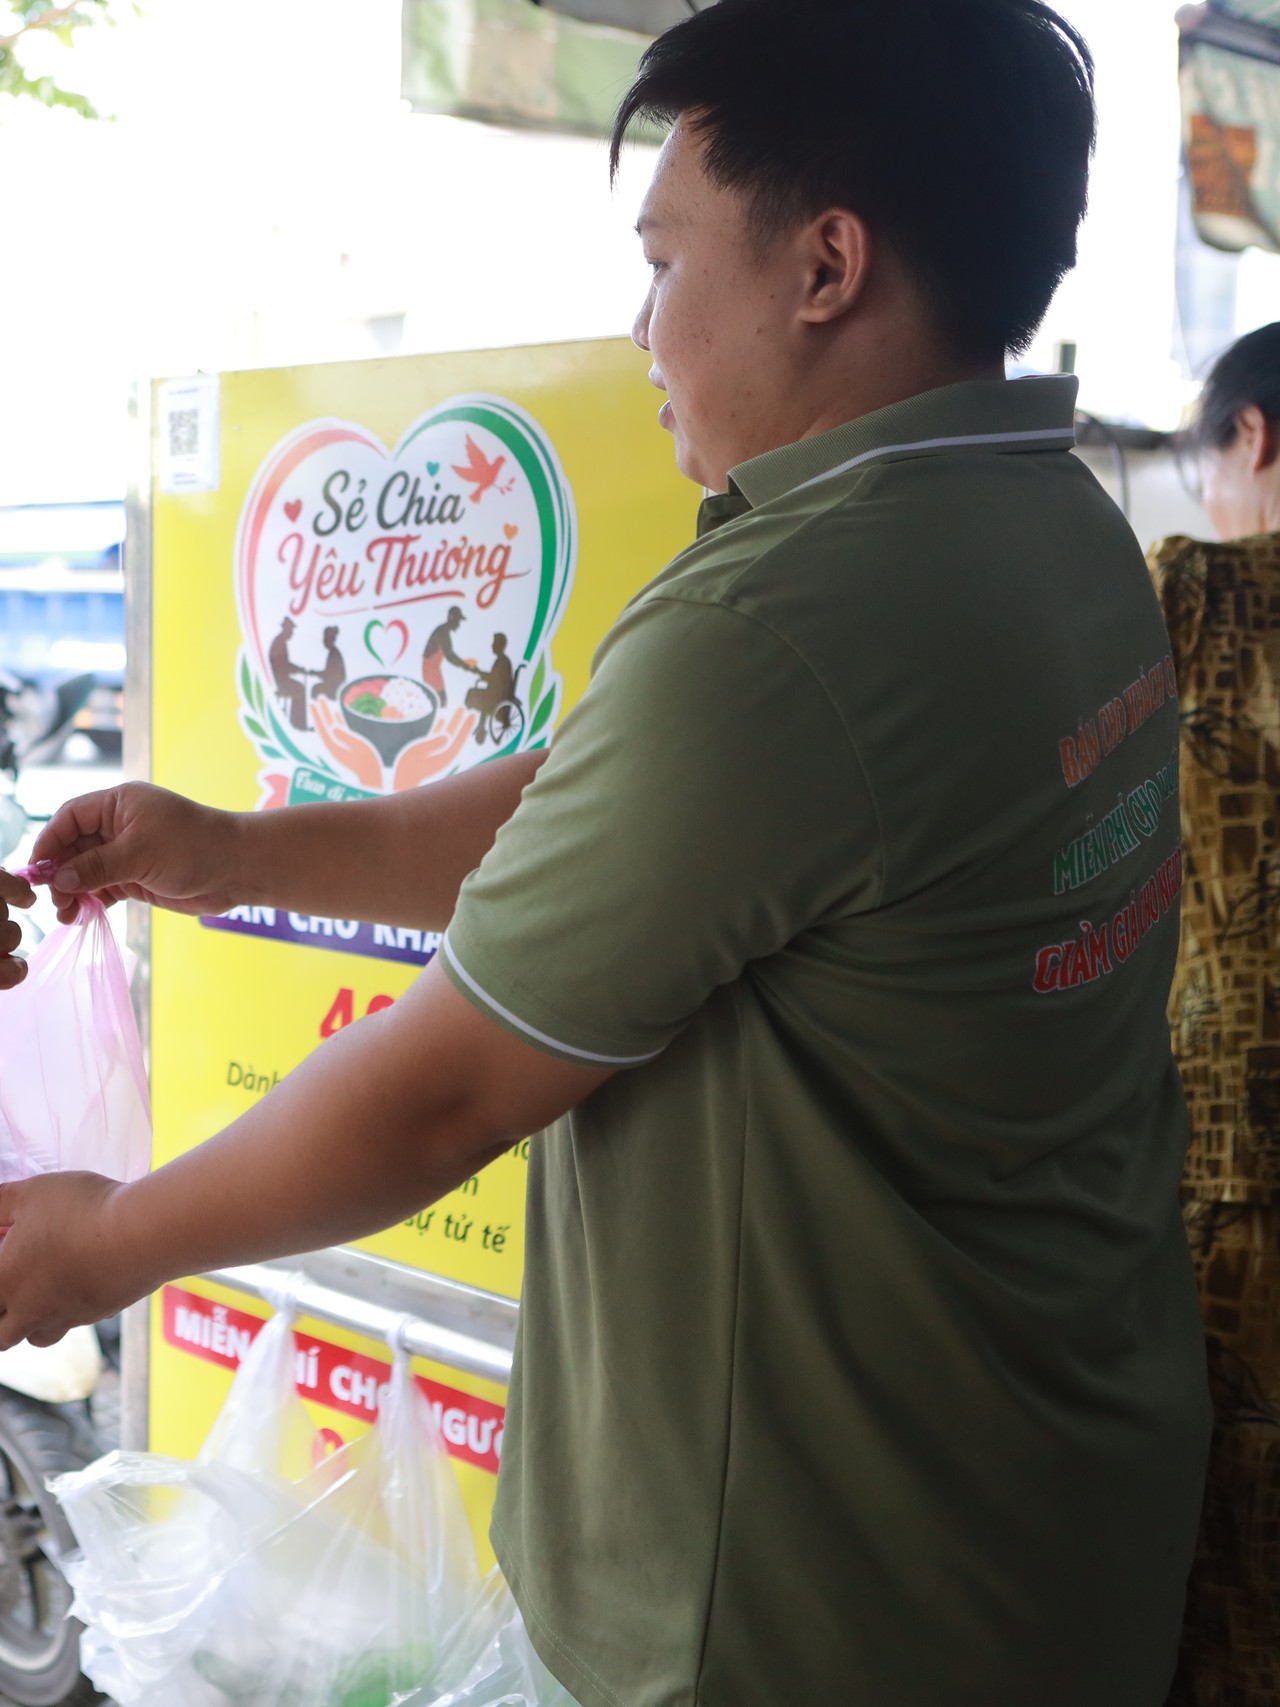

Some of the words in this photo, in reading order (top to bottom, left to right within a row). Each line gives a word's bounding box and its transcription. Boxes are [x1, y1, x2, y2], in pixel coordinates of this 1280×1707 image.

[312, 469, 368, 536] Sẻ
[376, 470, 466, 530] Chia
[278, 532, 365, 615] Yêu
[366, 534, 532, 609] Thương
[1058, 715, 1101, 788] BÁN
[1032, 920, 1114, 993] GIẢM
[444, 1213, 473, 1243] tử
[481, 1224, 511, 1254] tế
